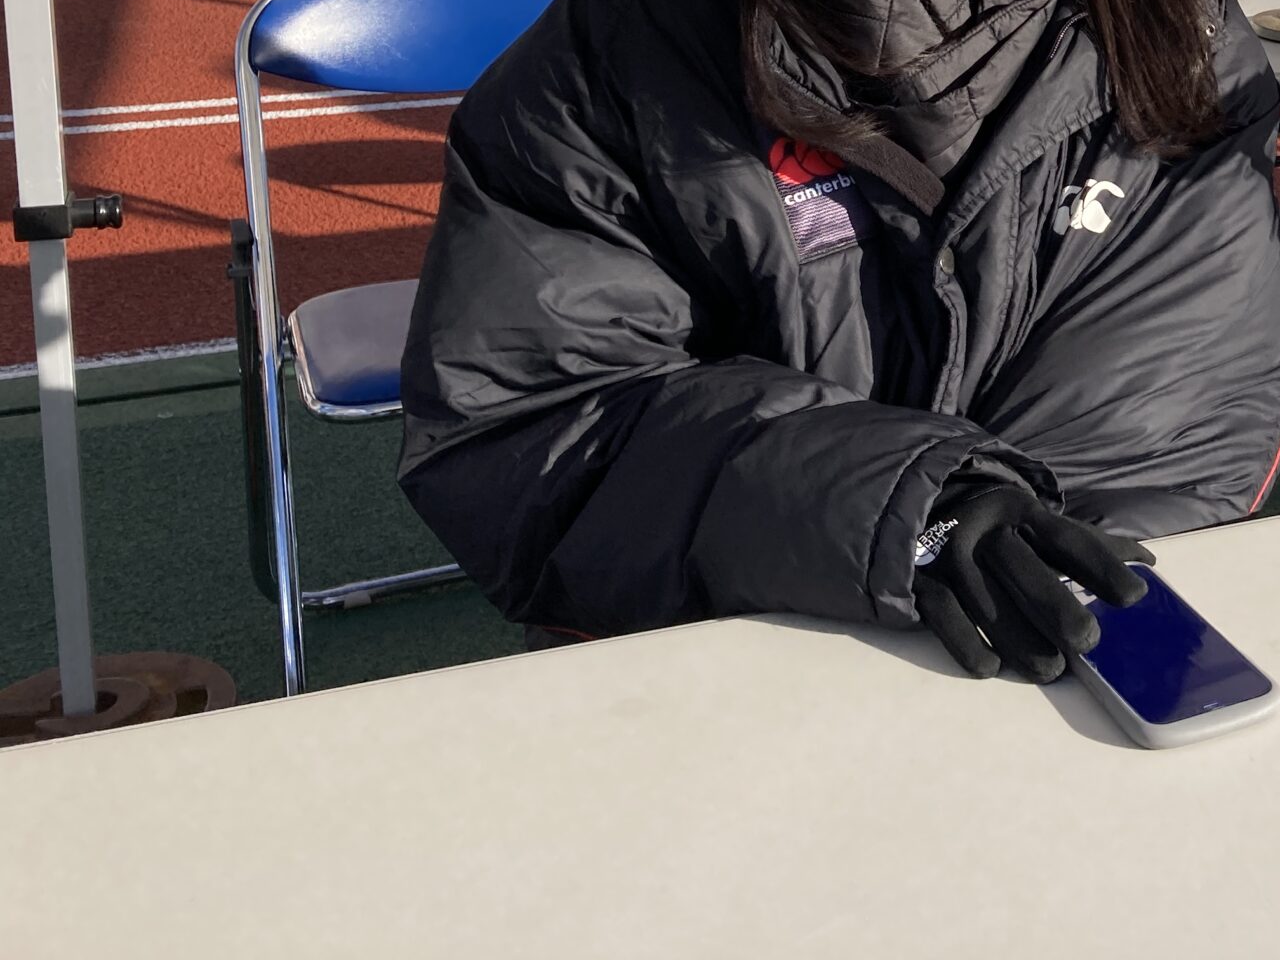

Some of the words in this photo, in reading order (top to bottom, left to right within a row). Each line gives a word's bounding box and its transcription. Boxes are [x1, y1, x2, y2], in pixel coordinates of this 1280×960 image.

[918, 520, 945, 545] FACE
[924, 518, 959, 551] NORTH
[931, 535, 950, 557] THE
